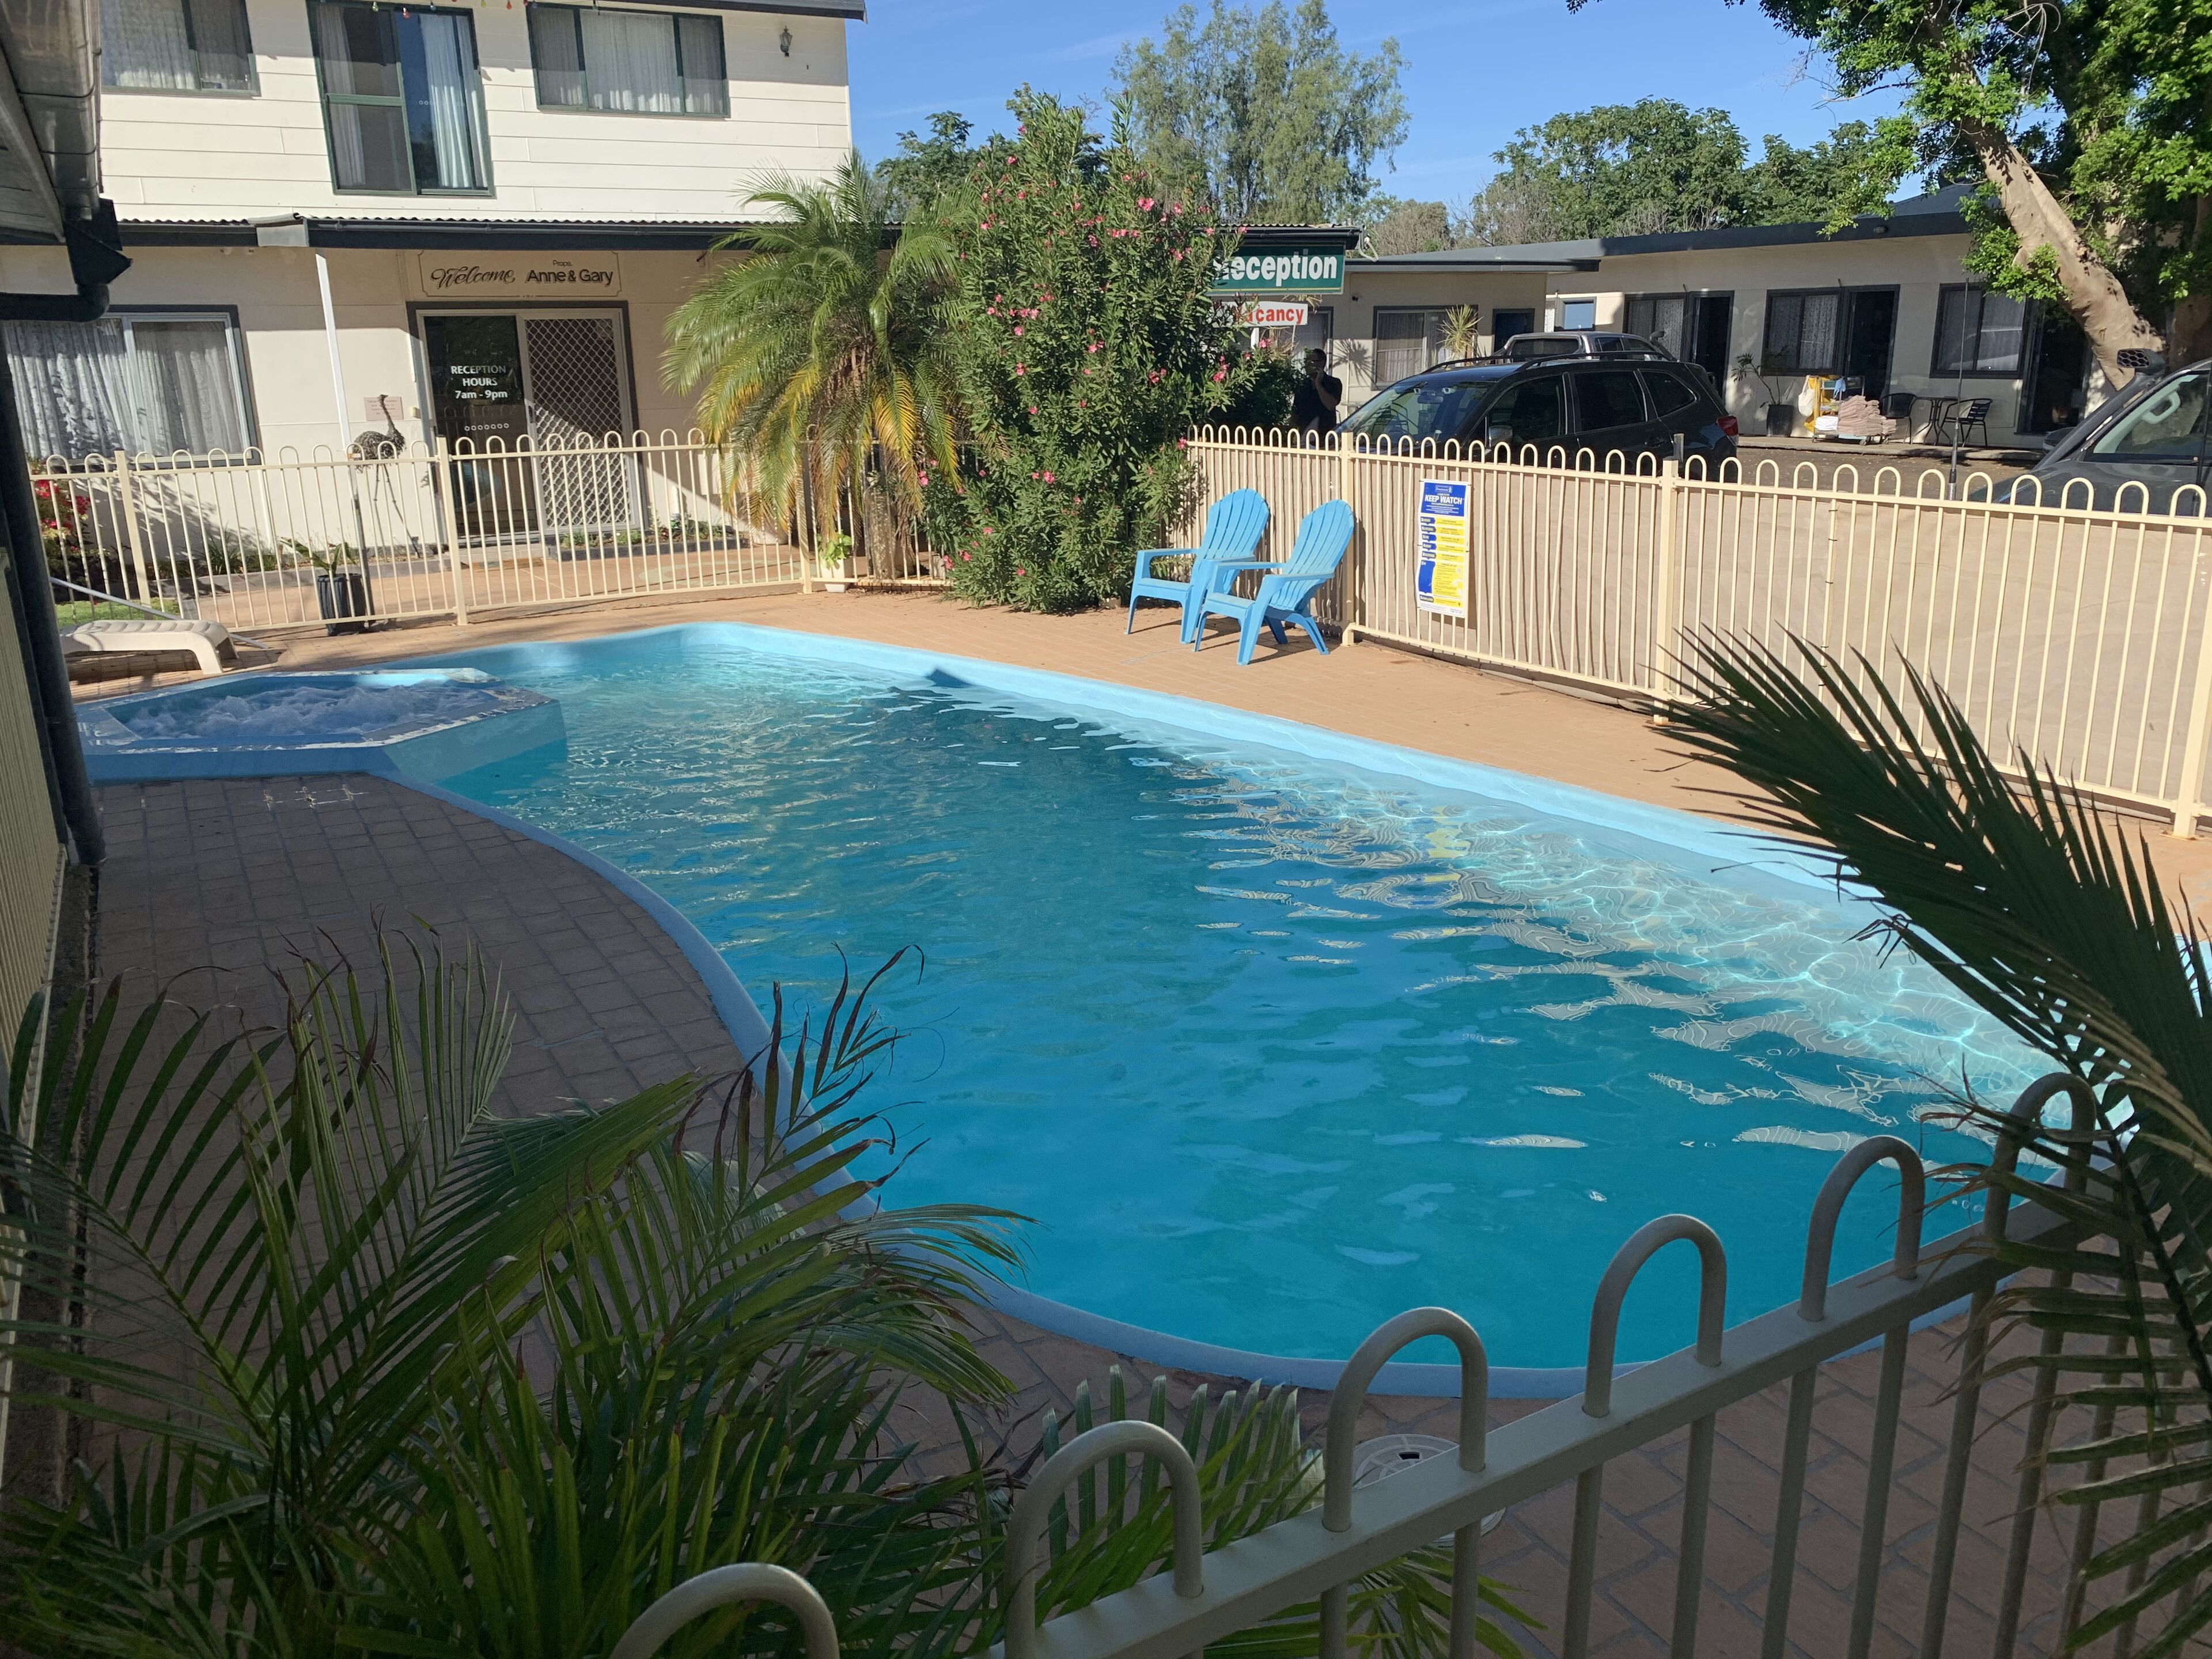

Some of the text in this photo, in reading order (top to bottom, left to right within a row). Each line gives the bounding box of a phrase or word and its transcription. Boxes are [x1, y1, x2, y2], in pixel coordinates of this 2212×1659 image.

[431, 266, 613, 289] Welcome Anne & Gary
[1235, 308, 1304, 325] cancy
[450, 365, 506, 374] RECEPTION
[463, 377, 498, 387] HOURS
[455, 391, 477, 399] 7am
[484, 389, 508, 400] 9pm
[1425, 494, 1440, 502] KEEP
[1440, 495, 1463, 505] WATCH
